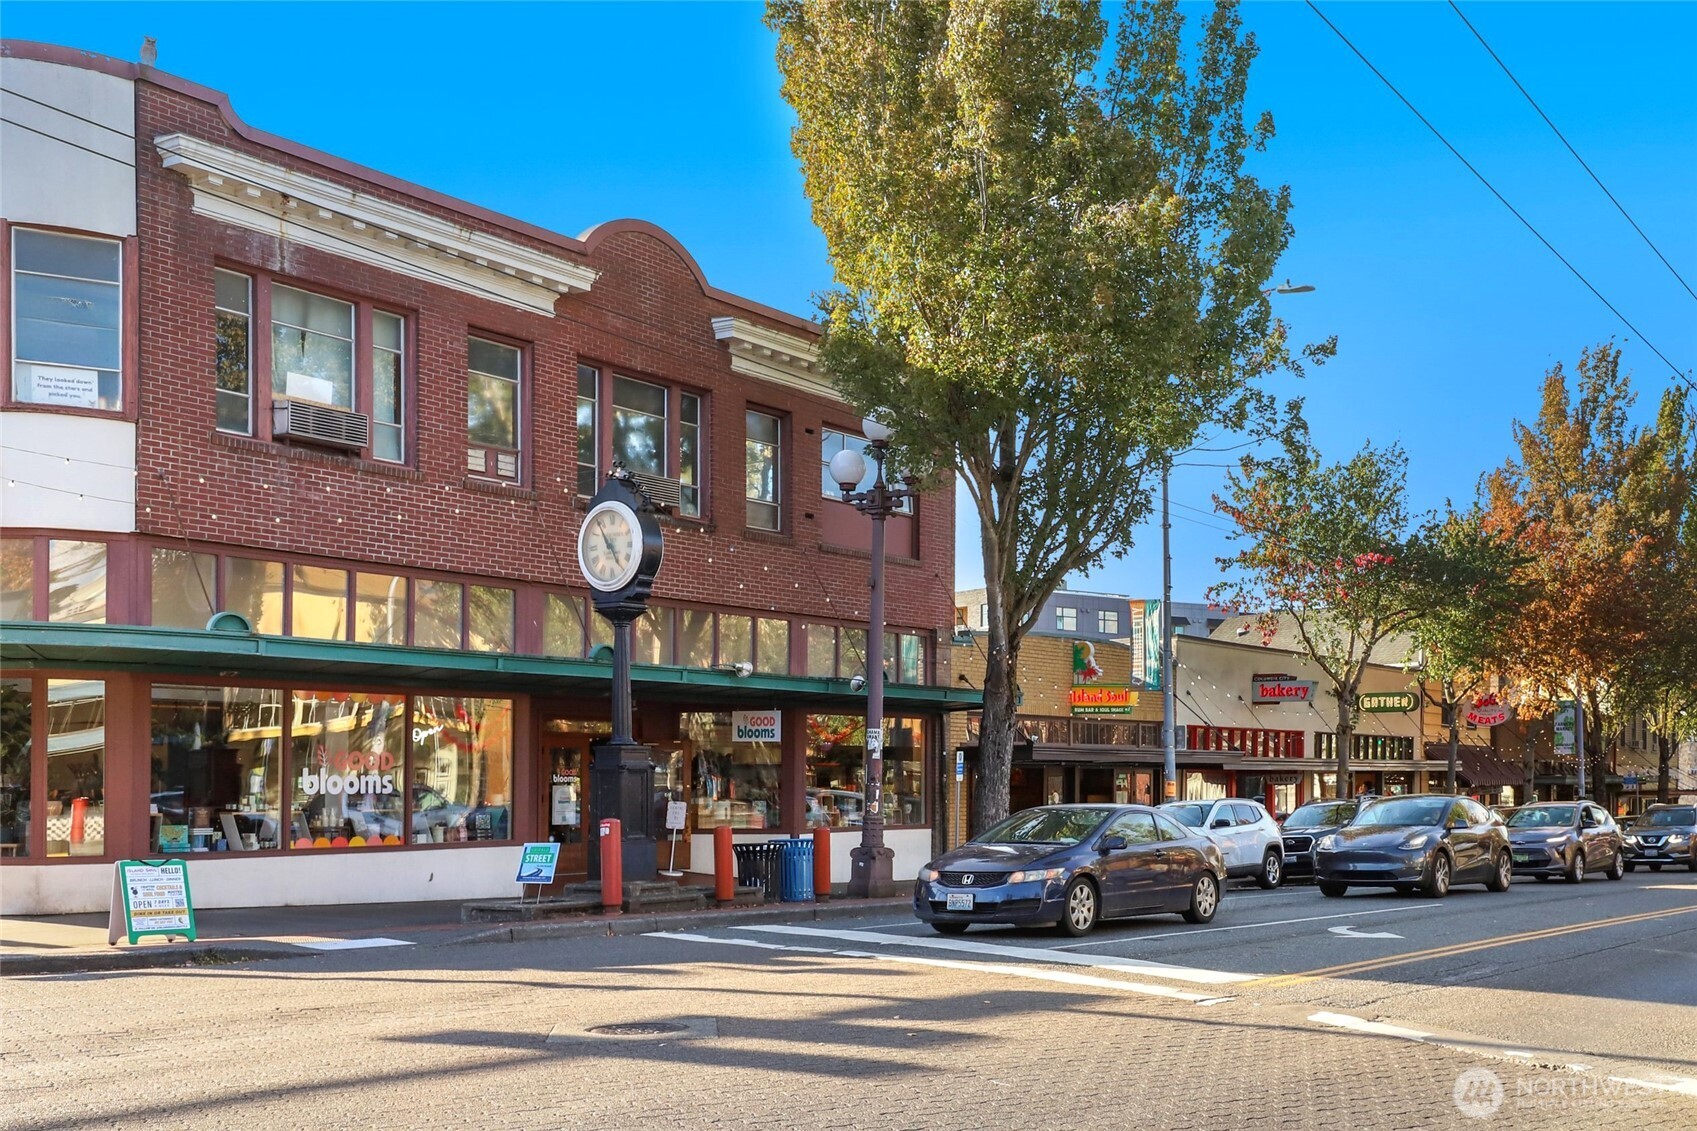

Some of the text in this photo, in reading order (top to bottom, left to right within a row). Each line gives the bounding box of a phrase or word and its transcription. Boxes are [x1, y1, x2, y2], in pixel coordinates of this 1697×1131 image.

[1132, 607, 1144, 628] CITY
[1072, 688, 1128, 702] Island Soul
[1259, 684, 1309, 700] bakery
[1362, 696, 1408, 708] GATHER
[750, 716, 775, 726] GOOD
[1467, 712, 1505, 724] MEATS
[412, 724, 444, 746] Open
[737, 725, 775, 738] blooms
[333, 750, 394, 771] GOOD
[302, 768, 393, 795] blooms
[553, 774, 577, 782] blooms
[1270, 775, 1298, 783] bakery
[525, 854, 552, 862] STREET
[133, 900, 152, 909] OPEN
